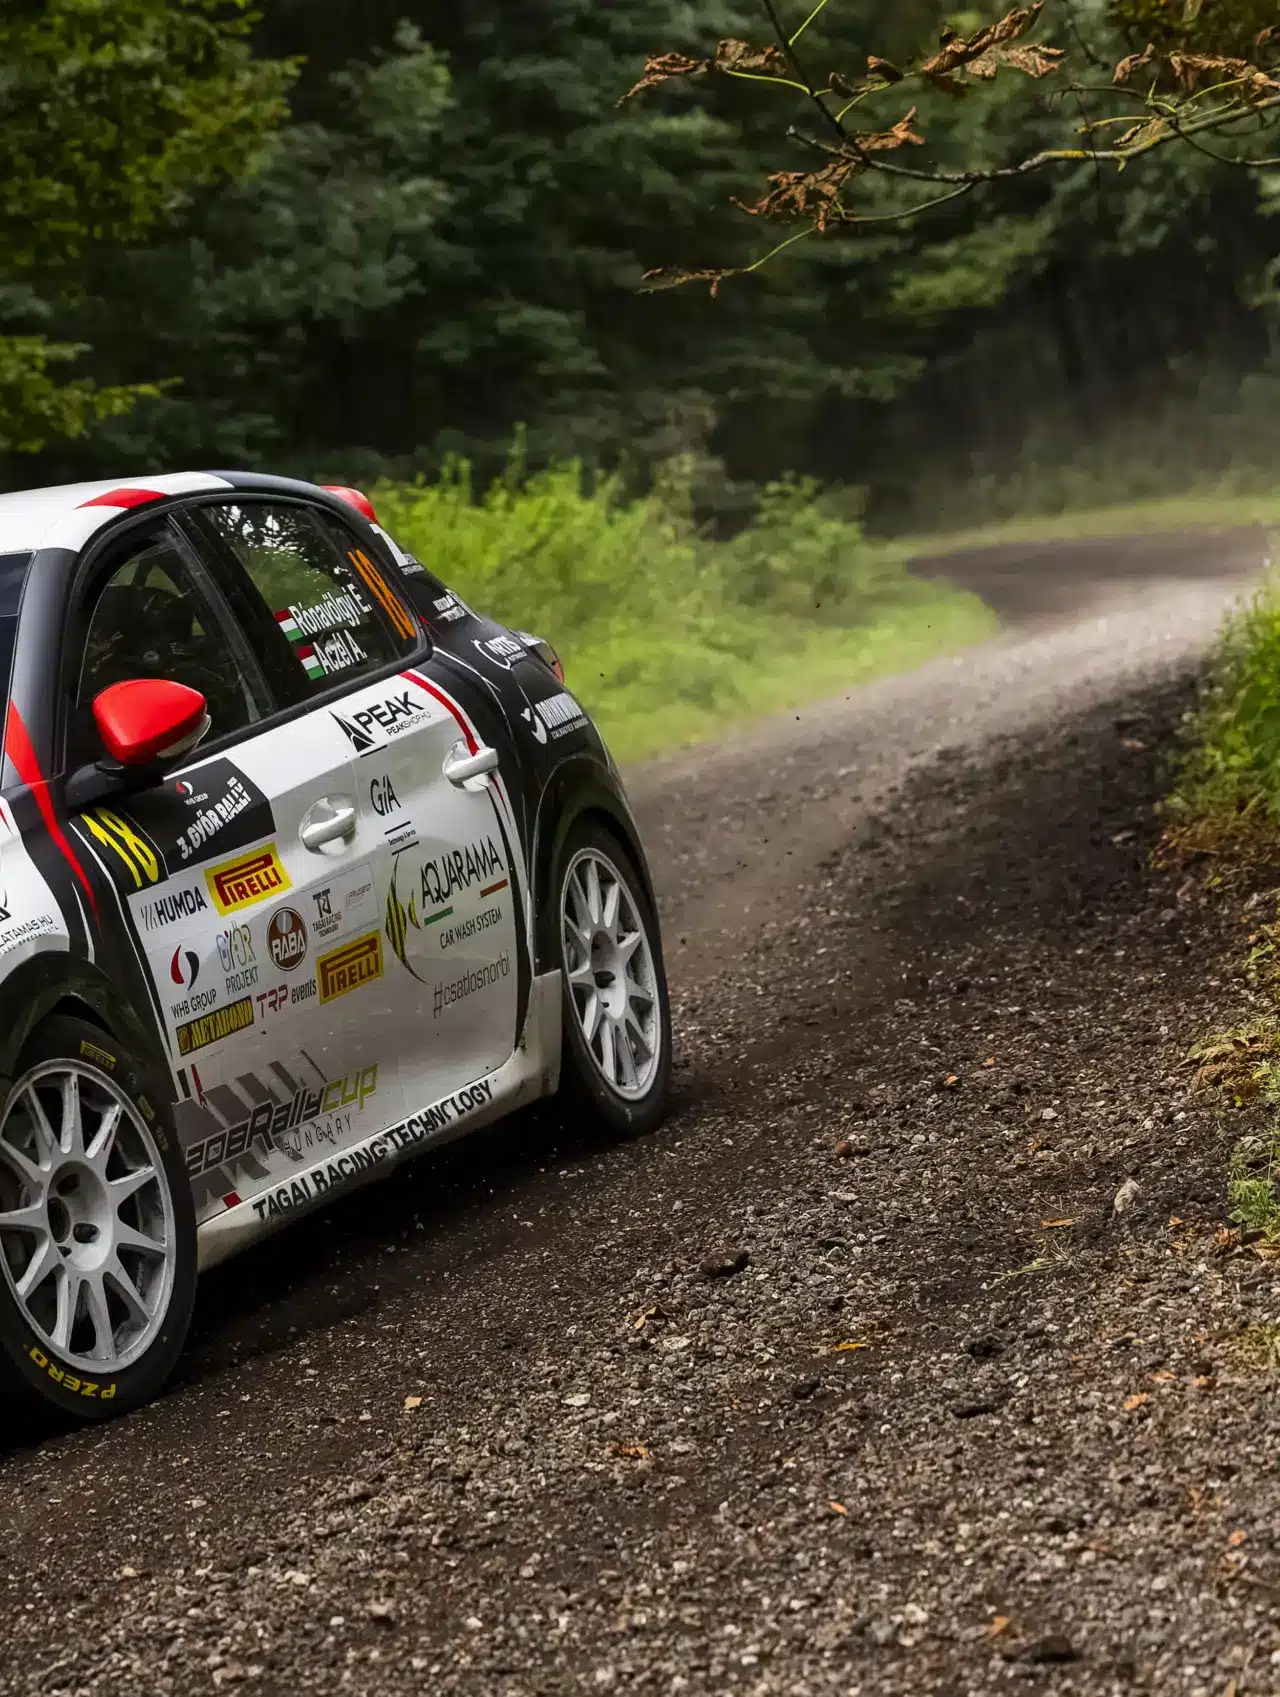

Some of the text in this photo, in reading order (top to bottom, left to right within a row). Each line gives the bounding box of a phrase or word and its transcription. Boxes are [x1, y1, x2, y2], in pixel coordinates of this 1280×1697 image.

[344, 629, 368, 663] A.
[352, 691, 425, 735] PEAK
[80, 807, 159, 888] 18
[176, 837, 193, 860] 3.
[214, 853, 283, 907] PIRELLI
[420, 835, 505, 910] AQUARAMA
[154, 886, 208, 926] HUMDA
[440, 906, 503, 950] CAR WASH SYSTEM
[225, 965, 259, 996] PROJEKT
[321, 937, 380, 999] PIRELLI
[171, 989, 217, 1019] WHB GROUP
[256, 978, 317, 1018] TRP events
[253, 1177, 312, 1221] TAGAI
[308, 1140, 387, 1193] RACING
